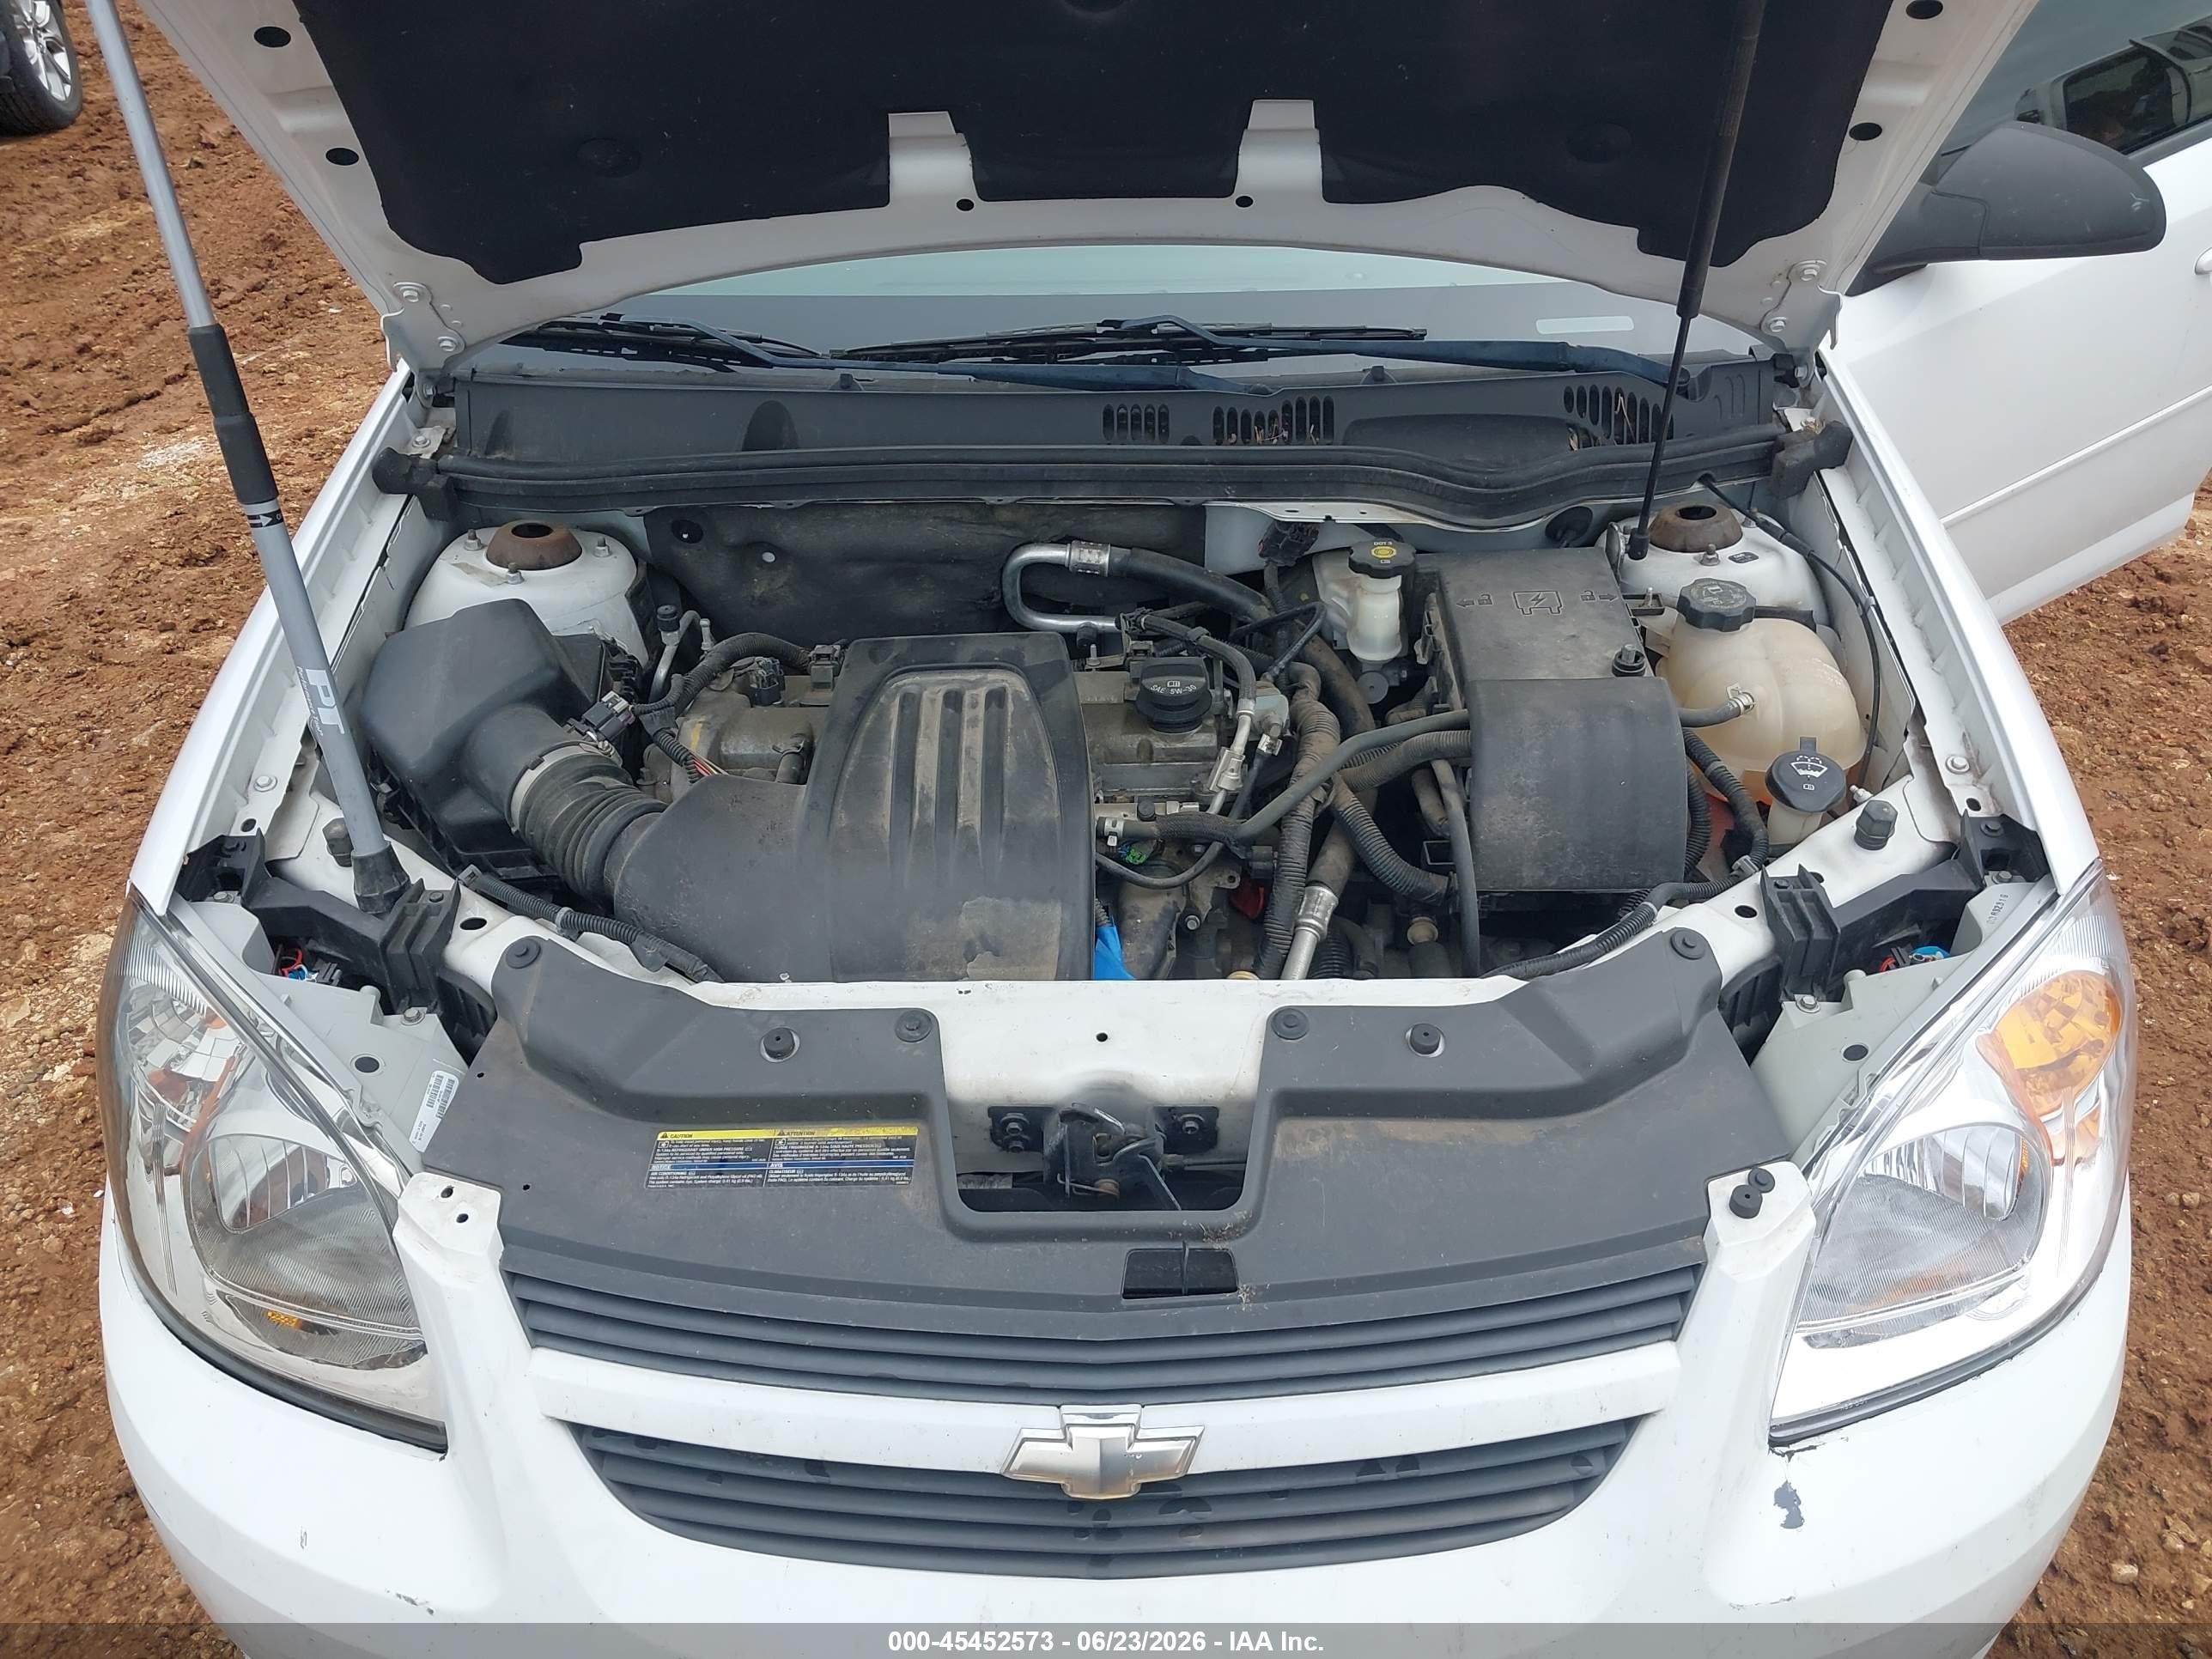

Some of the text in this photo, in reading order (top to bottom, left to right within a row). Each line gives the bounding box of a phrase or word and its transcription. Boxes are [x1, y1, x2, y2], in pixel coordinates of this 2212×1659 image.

[305, 669, 345, 734] PT
[1150, 684, 1197, 695] SAE 5W-30
